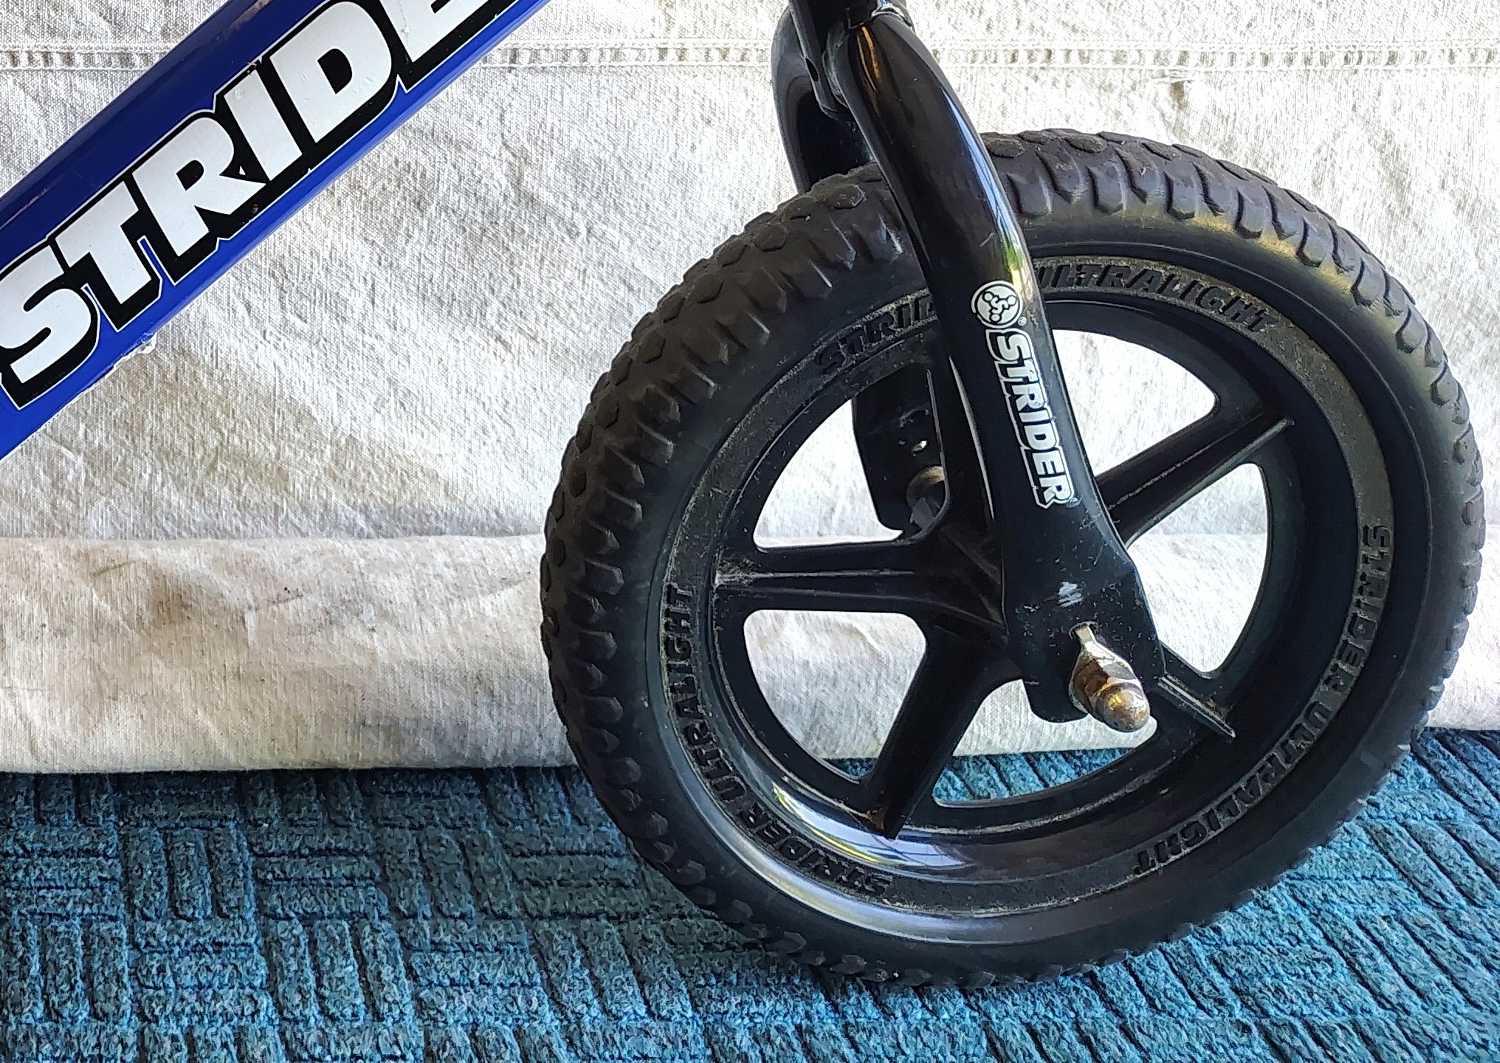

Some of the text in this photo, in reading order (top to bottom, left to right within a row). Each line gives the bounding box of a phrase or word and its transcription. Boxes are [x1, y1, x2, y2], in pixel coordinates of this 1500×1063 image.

[811, 291, 937, 376] STRID
[986, 329, 1075, 508] STRIDER
[660, 584, 894, 899] STRIDER ULTRALIGHT
[1127, 519, 1393, 876] STRIDER ULTRALIGHT
